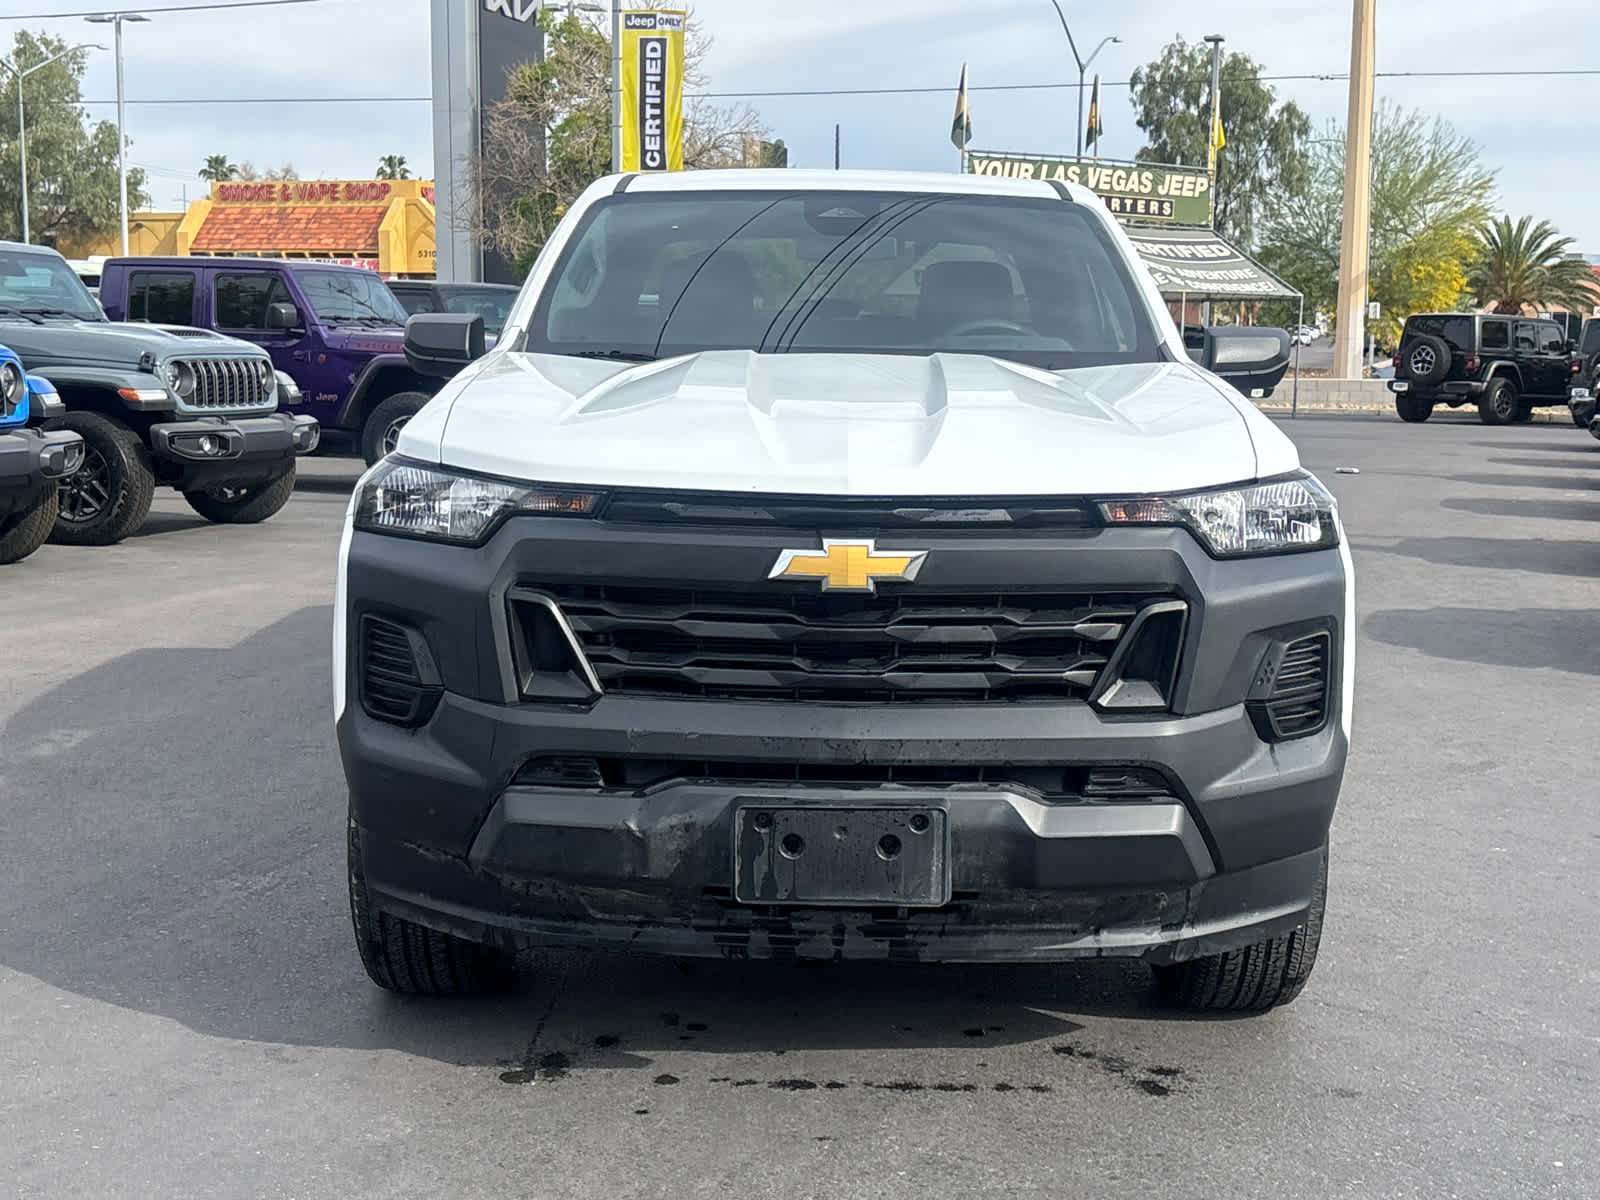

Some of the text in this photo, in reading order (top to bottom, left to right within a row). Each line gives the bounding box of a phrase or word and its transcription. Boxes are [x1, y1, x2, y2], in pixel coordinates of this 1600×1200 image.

[626, 15, 682, 28] Jeep ONLY
[645, 40, 662, 168] CERTIFIED
[973, 159, 1208, 198] YOUR LAS VEGAS JEEP
[217, 182, 391, 201] SMOKE & VAPE SHOP
[1101, 197, 1172, 216] RTERS
[1131, 241, 1231, 258] ERTIFIED
